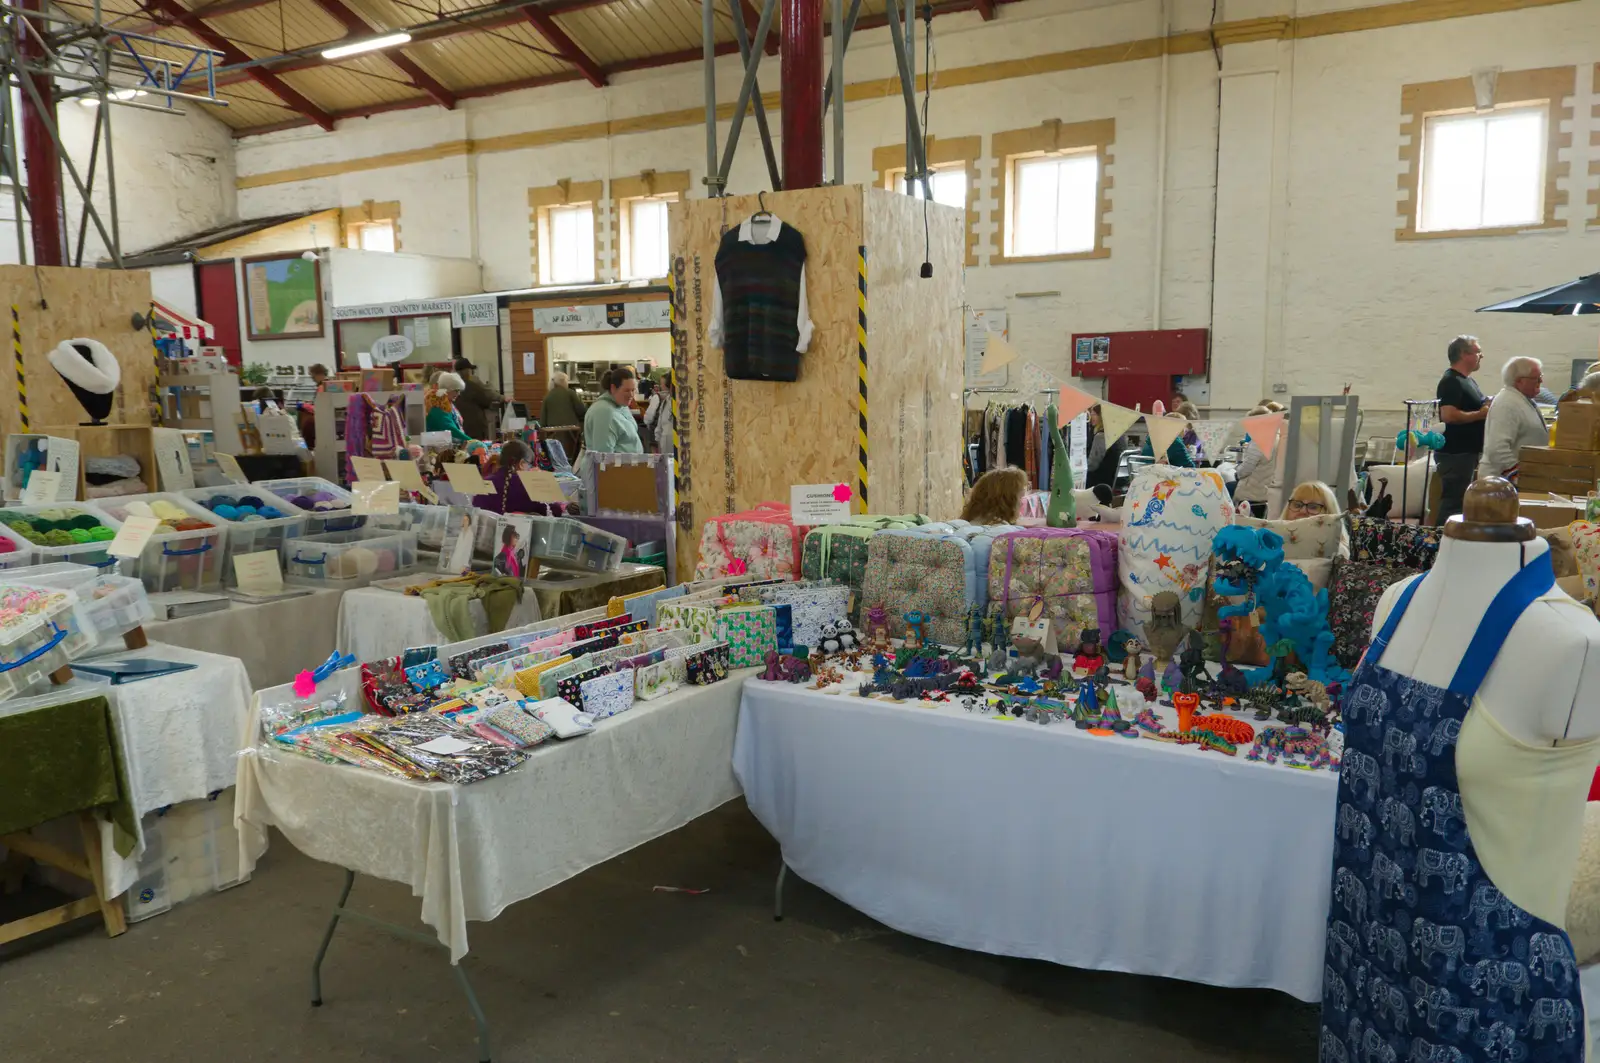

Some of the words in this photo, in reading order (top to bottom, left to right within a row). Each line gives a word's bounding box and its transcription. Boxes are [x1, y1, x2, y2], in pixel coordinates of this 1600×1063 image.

[693, 256, 701, 274] on
[674, 257, 687, 321] Zero
[693, 278, 702, 313] build
[336, 309, 357, 317] SOUTH
[358, 307, 384, 315] MOLTON
[389, 304, 420, 314] COUNTRY
[421, 302, 452, 311] MARKETS
[468, 303, 493, 311] COUNTRY
[469, 310, 495, 318] MARKETS
[695, 317, 703, 341] can
[696, 345, 705, 370] you
[697, 373, 706, 431] Strength
